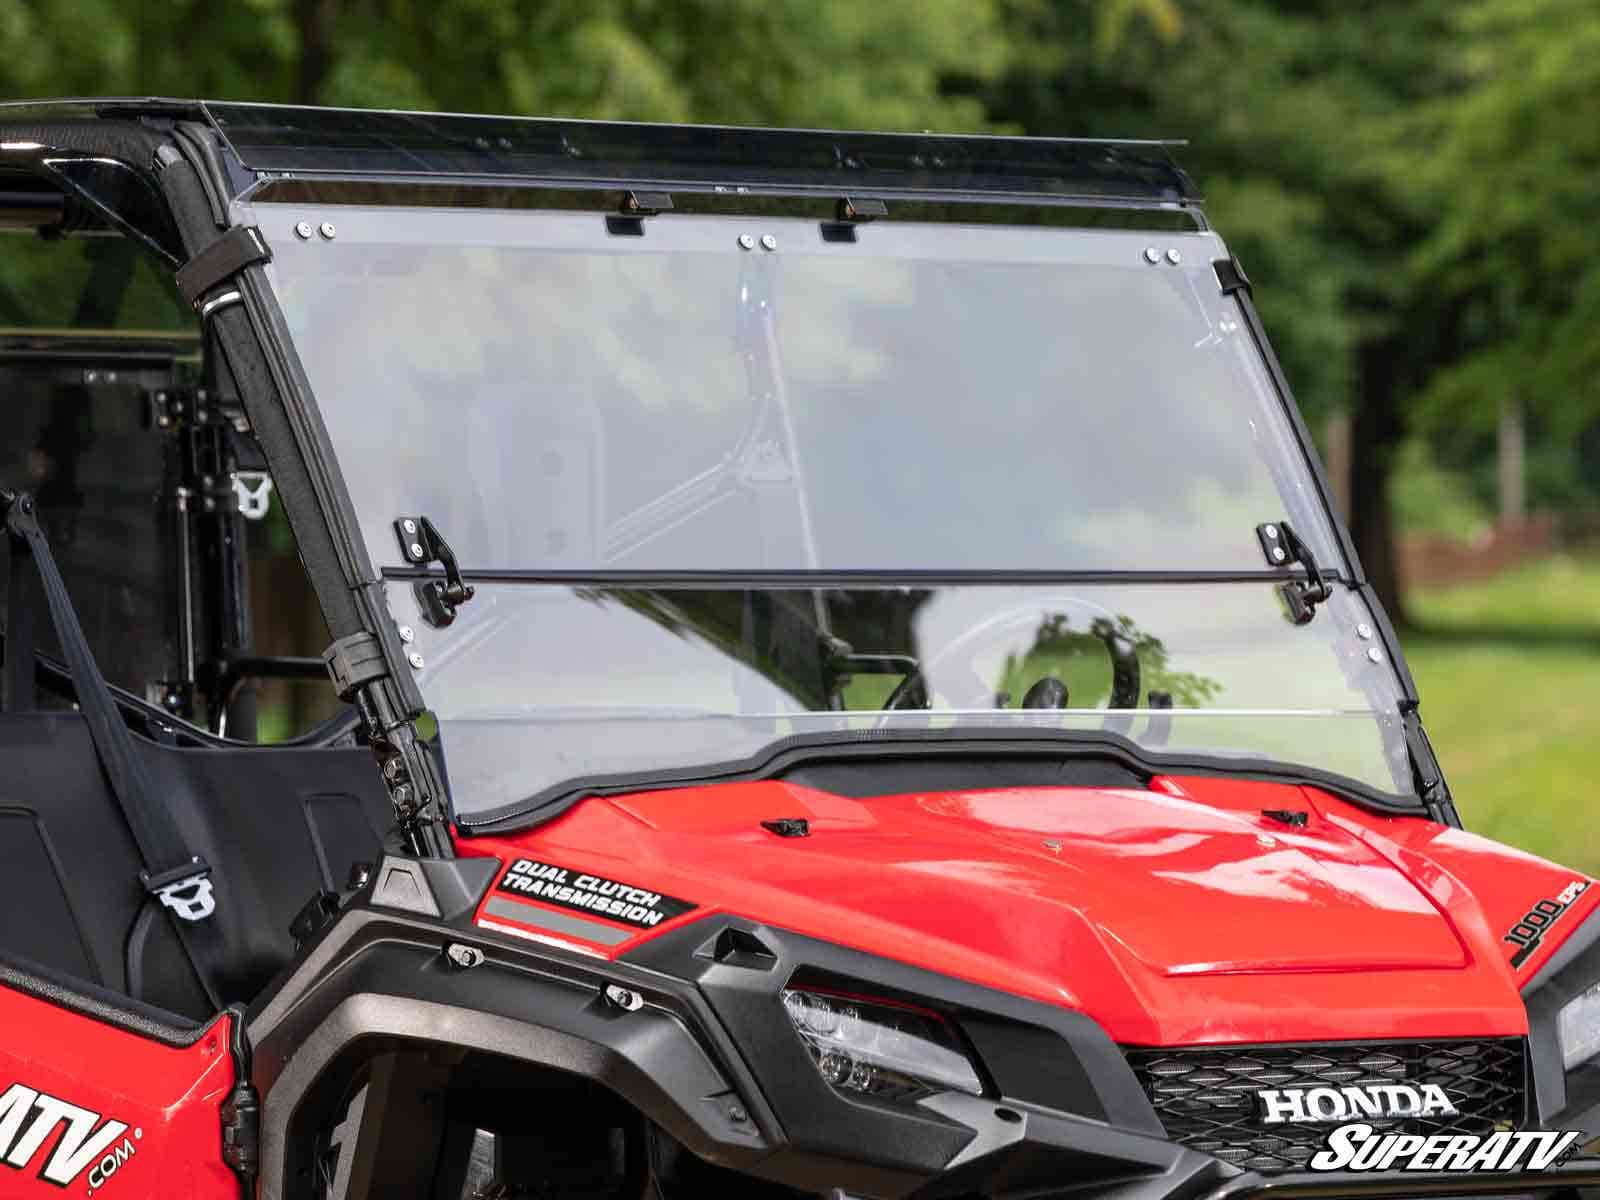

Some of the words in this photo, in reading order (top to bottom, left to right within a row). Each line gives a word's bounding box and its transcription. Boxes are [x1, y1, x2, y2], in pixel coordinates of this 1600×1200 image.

[502, 872, 664, 926] TRANSMISSION
[512, 859, 568, 883] DUAL
[573, 874, 662, 908] CLUTCH
[1503, 899, 1563, 946] 1000
[1258, 1084, 1459, 1123] HONDA
